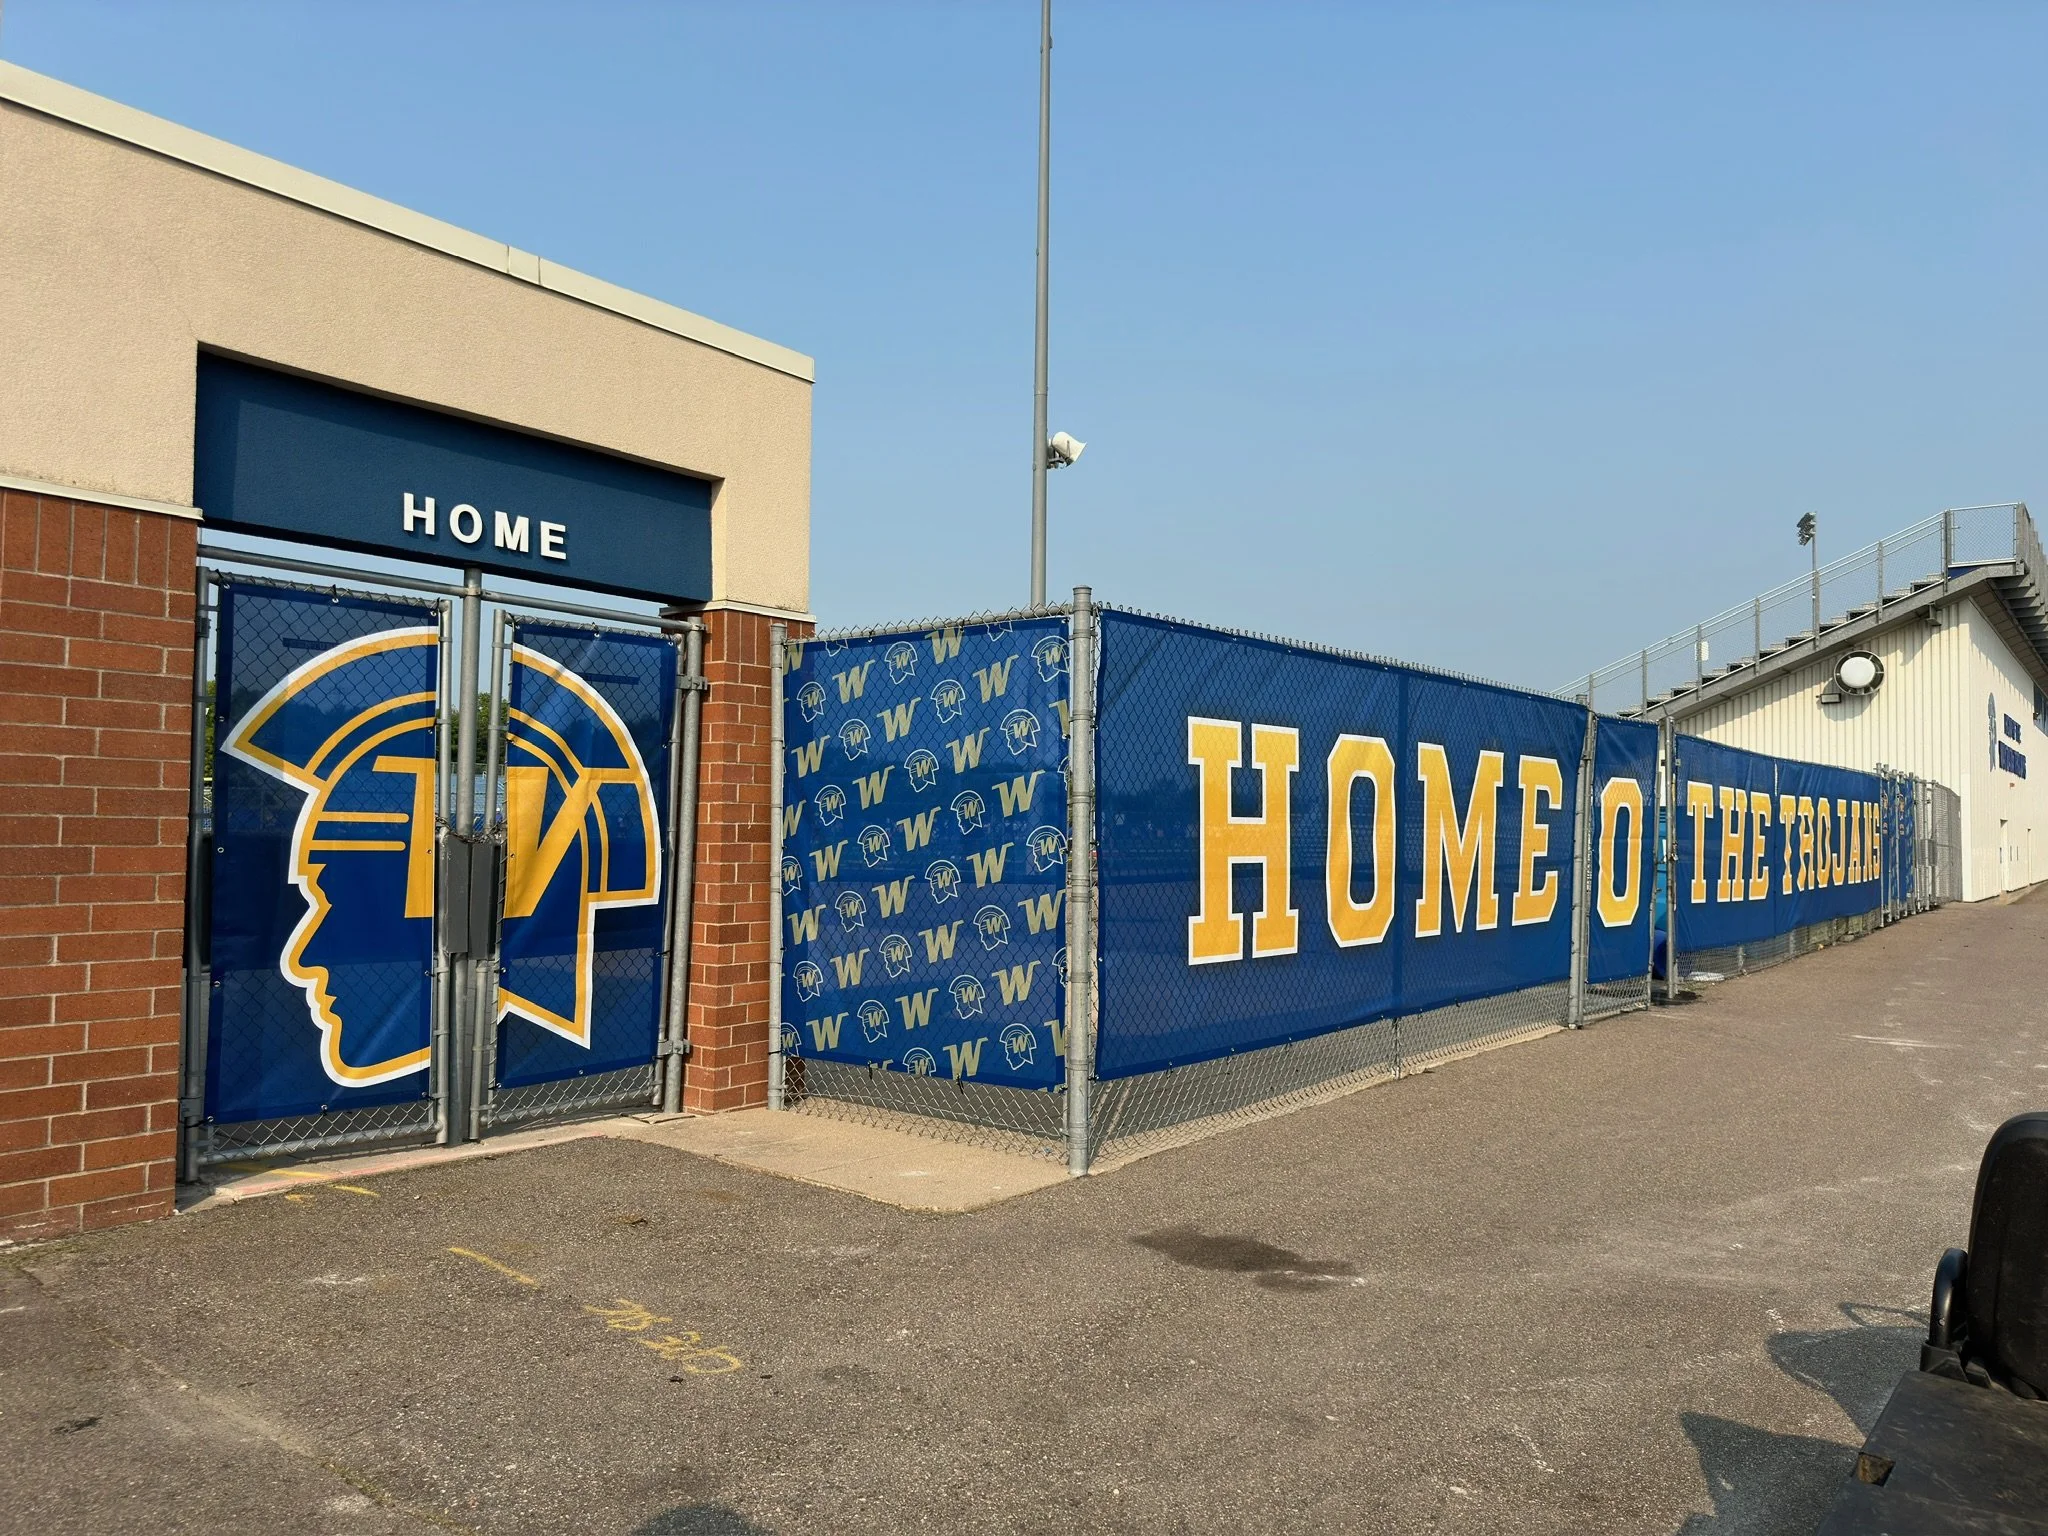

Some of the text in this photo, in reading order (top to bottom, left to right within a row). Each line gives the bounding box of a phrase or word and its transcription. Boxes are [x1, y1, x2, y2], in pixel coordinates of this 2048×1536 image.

[403, 492, 567, 560] HOME
[893, 650, 911, 669] W
[925, 628, 963, 665] W
[1042, 644, 1064, 665] W
[805, 689, 821, 708] W
[832, 659, 875, 704] W
[940, 688, 960, 707] W
[972, 654, 1019, 703] W
[848, 726, 866, 746] W
[877, 697, 921, 743] W
[1011, 717, 1033, 739] W
[791, 735, 830, 778] W
[913, 757, 933, 777] W
[946, 727, 990, 774] W
[823, 793, 842, 811] W
[852, 765, 895, 810] W
[992, 769, 1045, 817] W
[896, 806, 941, 851] W
[961, 799, 981, 819] W
[866, 834, 885, 853] W
[1038, 835, 1060, 855] W
[1187, 716, 1563, 965] HOME
[1687, 780, 1771, 904] THE
[1779, 794, 1880, 896] TROJANS
[809, 840, 848, 882] W
[934, 869, 955, 888] W
[966, 842, 1015, 888] W
[844, 899, 861, 918] W
[872, 875, 916, 919] W
[1018, 889, 1066, 935] W
[787, 904, 826, 945] W
[918, 920, 964, 963] W
[983, 915, 1005, 934] W
[830, 948, 870, 989] W
[887, 944, 906, 962] W
[799, 969, 817, 988] W
[958, 984, 979, 1003] W
[992, 960, 1041, 1005] W
[866, 1010, 884, 1028] W
[895, 988, 939, 1030] W
[806, 1012, 849, 1052] W
[1010, 1034, 1030, 1053] W
[943, 1037, 989, 1080] W
